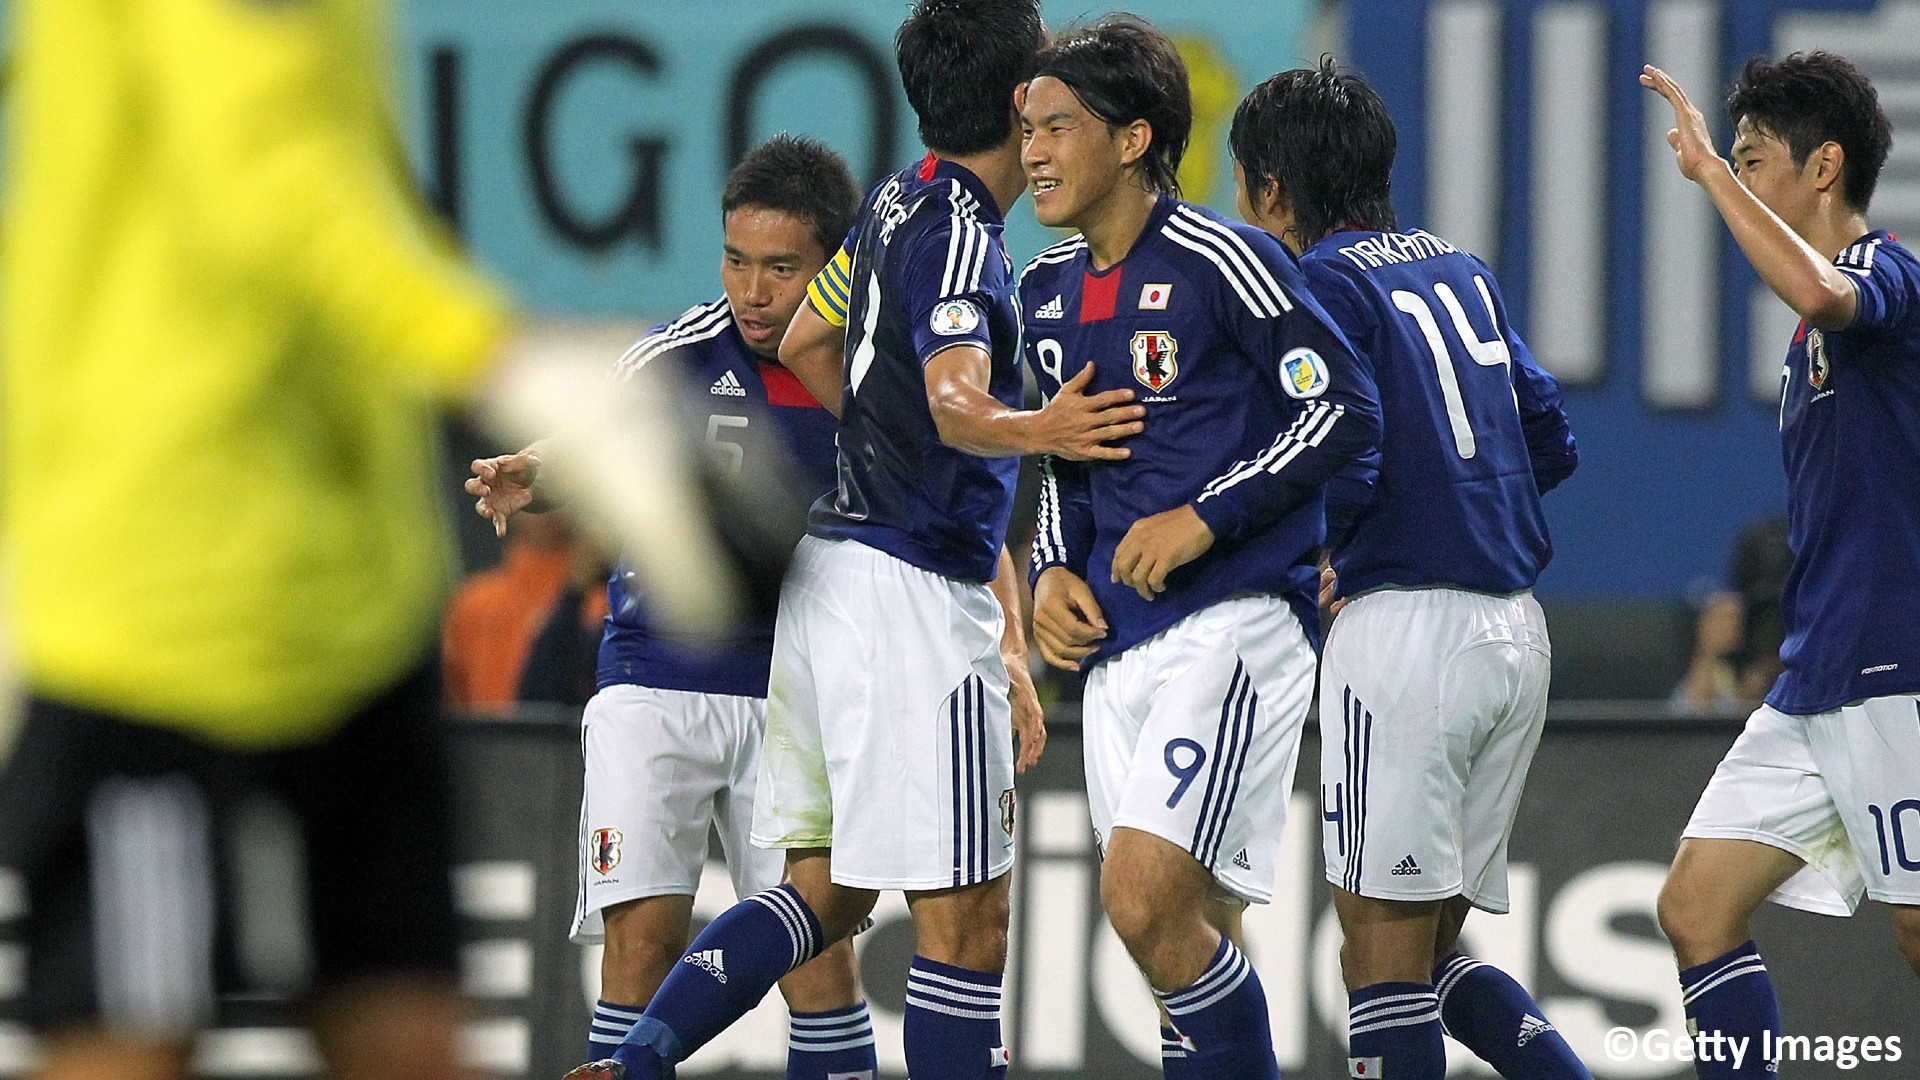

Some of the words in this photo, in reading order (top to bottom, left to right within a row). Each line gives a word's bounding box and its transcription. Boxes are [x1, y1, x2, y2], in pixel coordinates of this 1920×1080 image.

[1391, 275, 1518, 459] 14
[710, 385, 747, 397] adidas
[1141, 395, 1178, 403] JAPAN
[705, 414, 749, 477] 5
[1164, 737, 1207, 810] 9
[1867, 799, 1920, 876] 10
[1391, 866, 1422, 876] adidas
[684, 955, 728, 985] adidas
